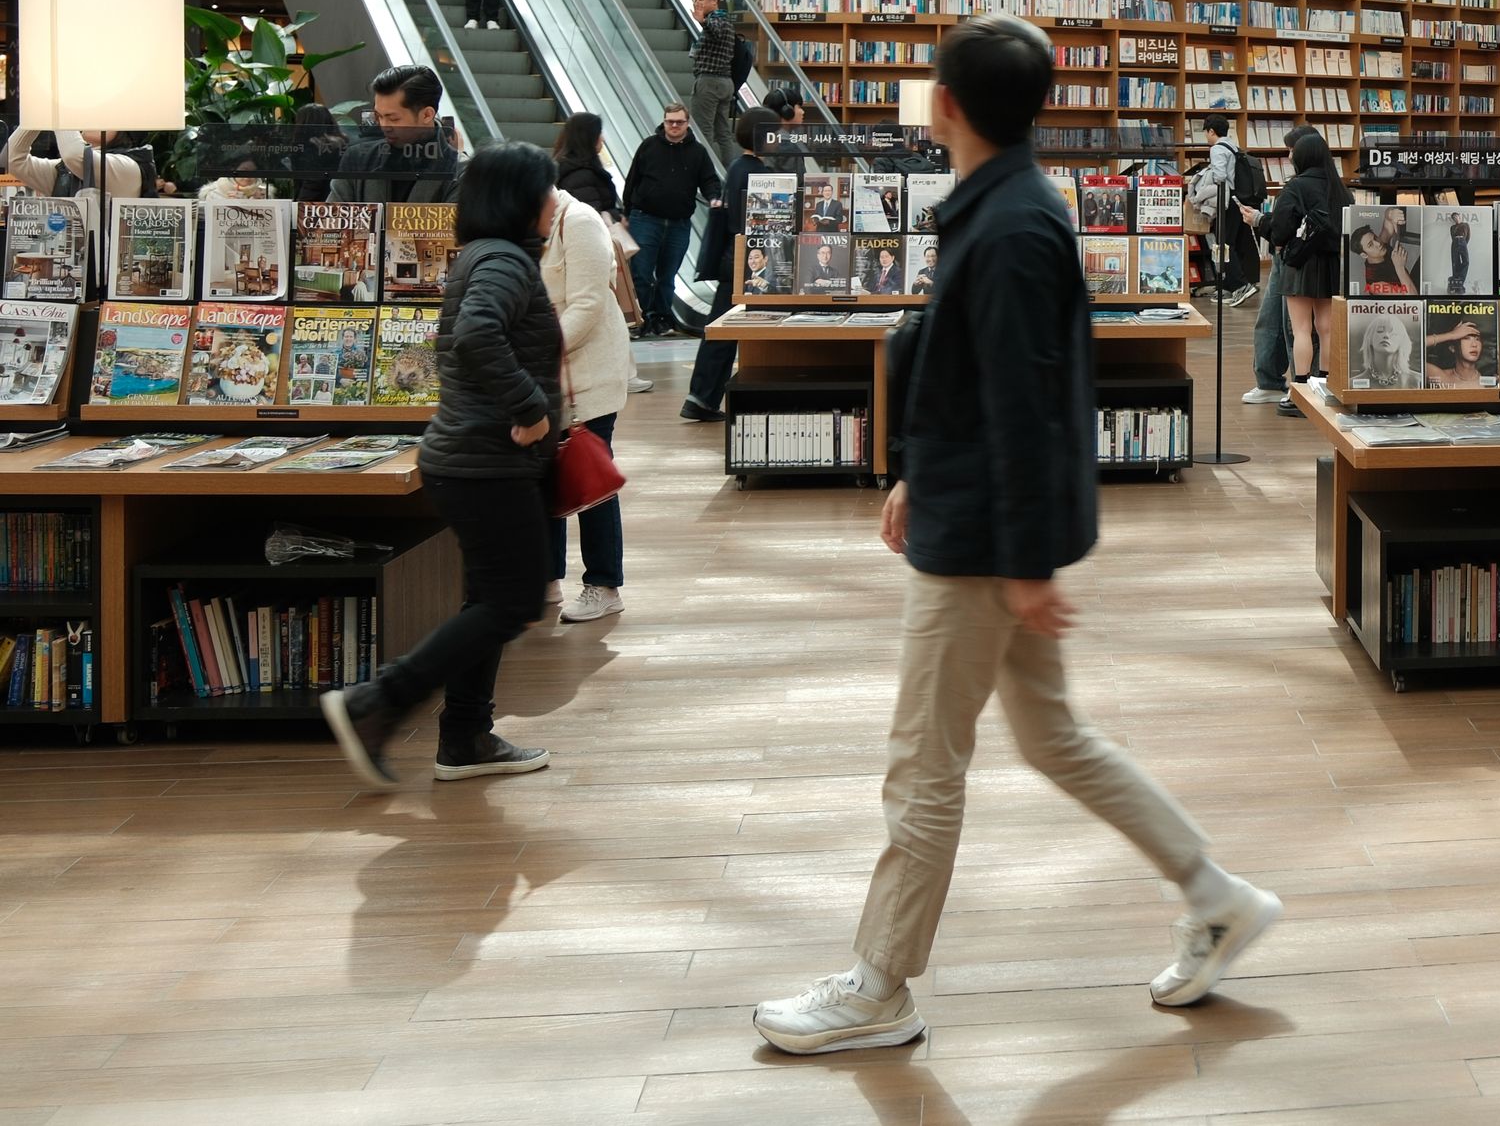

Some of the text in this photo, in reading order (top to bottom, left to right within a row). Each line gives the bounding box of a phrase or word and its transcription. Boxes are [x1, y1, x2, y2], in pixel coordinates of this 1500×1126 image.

[1138, 38, 1178, 51] 비즈니스
[1138, 51, 1178, 64] 라이브러리
[766, 133, 782, 144] D1
[789, 134, 865, 144] 경제 시사 주간지
[1369, 149, 1392, 166] D5
[751, 180, 775, 189] Insight
[12, 200, 43, 215] Ideal
[46, 201, 81, 218] Home
[123, 208, 183, 220] HOMES
[216, 208, 273, 221] HOMES
[10, 218, 39, 231] happy
[302, 217, 371, 230] GARDEN
[14, 227, 42, 236] home
[855, 238, 900, 249] LEADERS
[1143, 241, 1180, 251] MIDAS
[1365, 281, 1409, 294] ARENA
[0, 302, 68, 319] CASA Chic
[1351, 302, 1419, 315] marie claire
[1428, 301, 1495, 315] marie claire
[295, 317, 373, 331] Gardeners'
[292, 329, 338, 342] World
[381, 331, 425, 344] World
